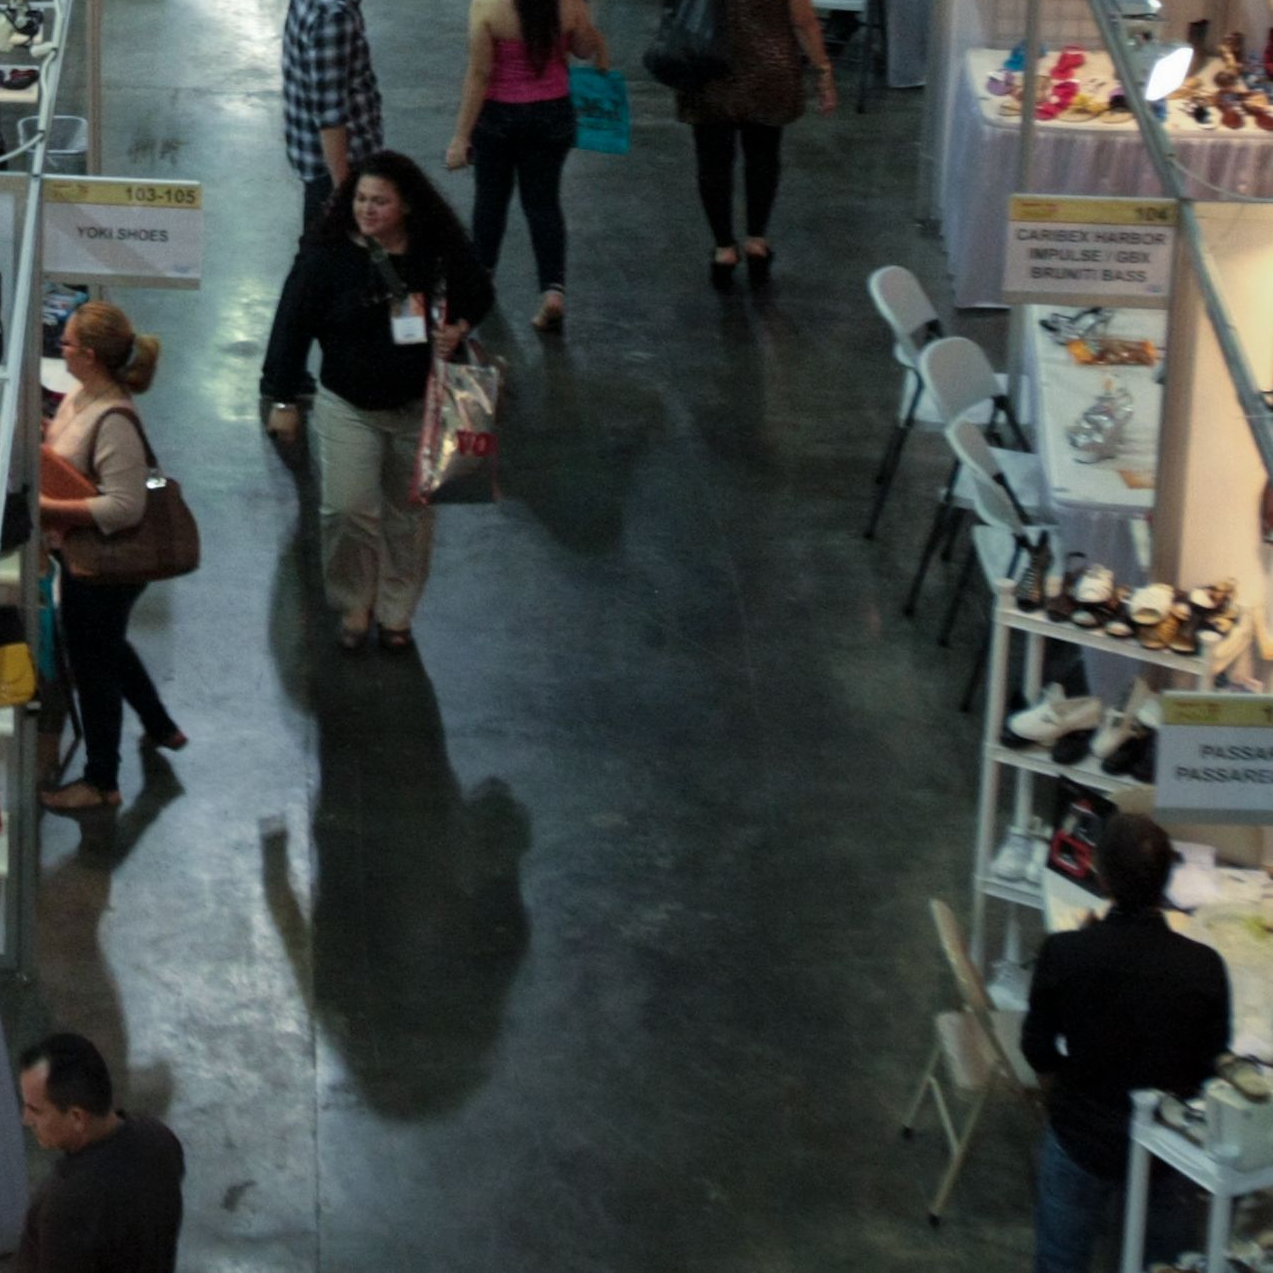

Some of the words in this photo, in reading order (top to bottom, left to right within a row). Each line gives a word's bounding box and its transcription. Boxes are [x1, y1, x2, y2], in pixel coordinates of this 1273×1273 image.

[126, 186, 197, 204] 103-105
[76, 226, 113, 240] YOKI
[116, 227, 169, 242] SHOES
[1016, 228, 1090, 243] CARIBEX
[1094, 230, 1167, 245] HARBOR
[1029, 247, 1102, 262] IMPULSE
[1102, 268, 1148, 283] BASS
